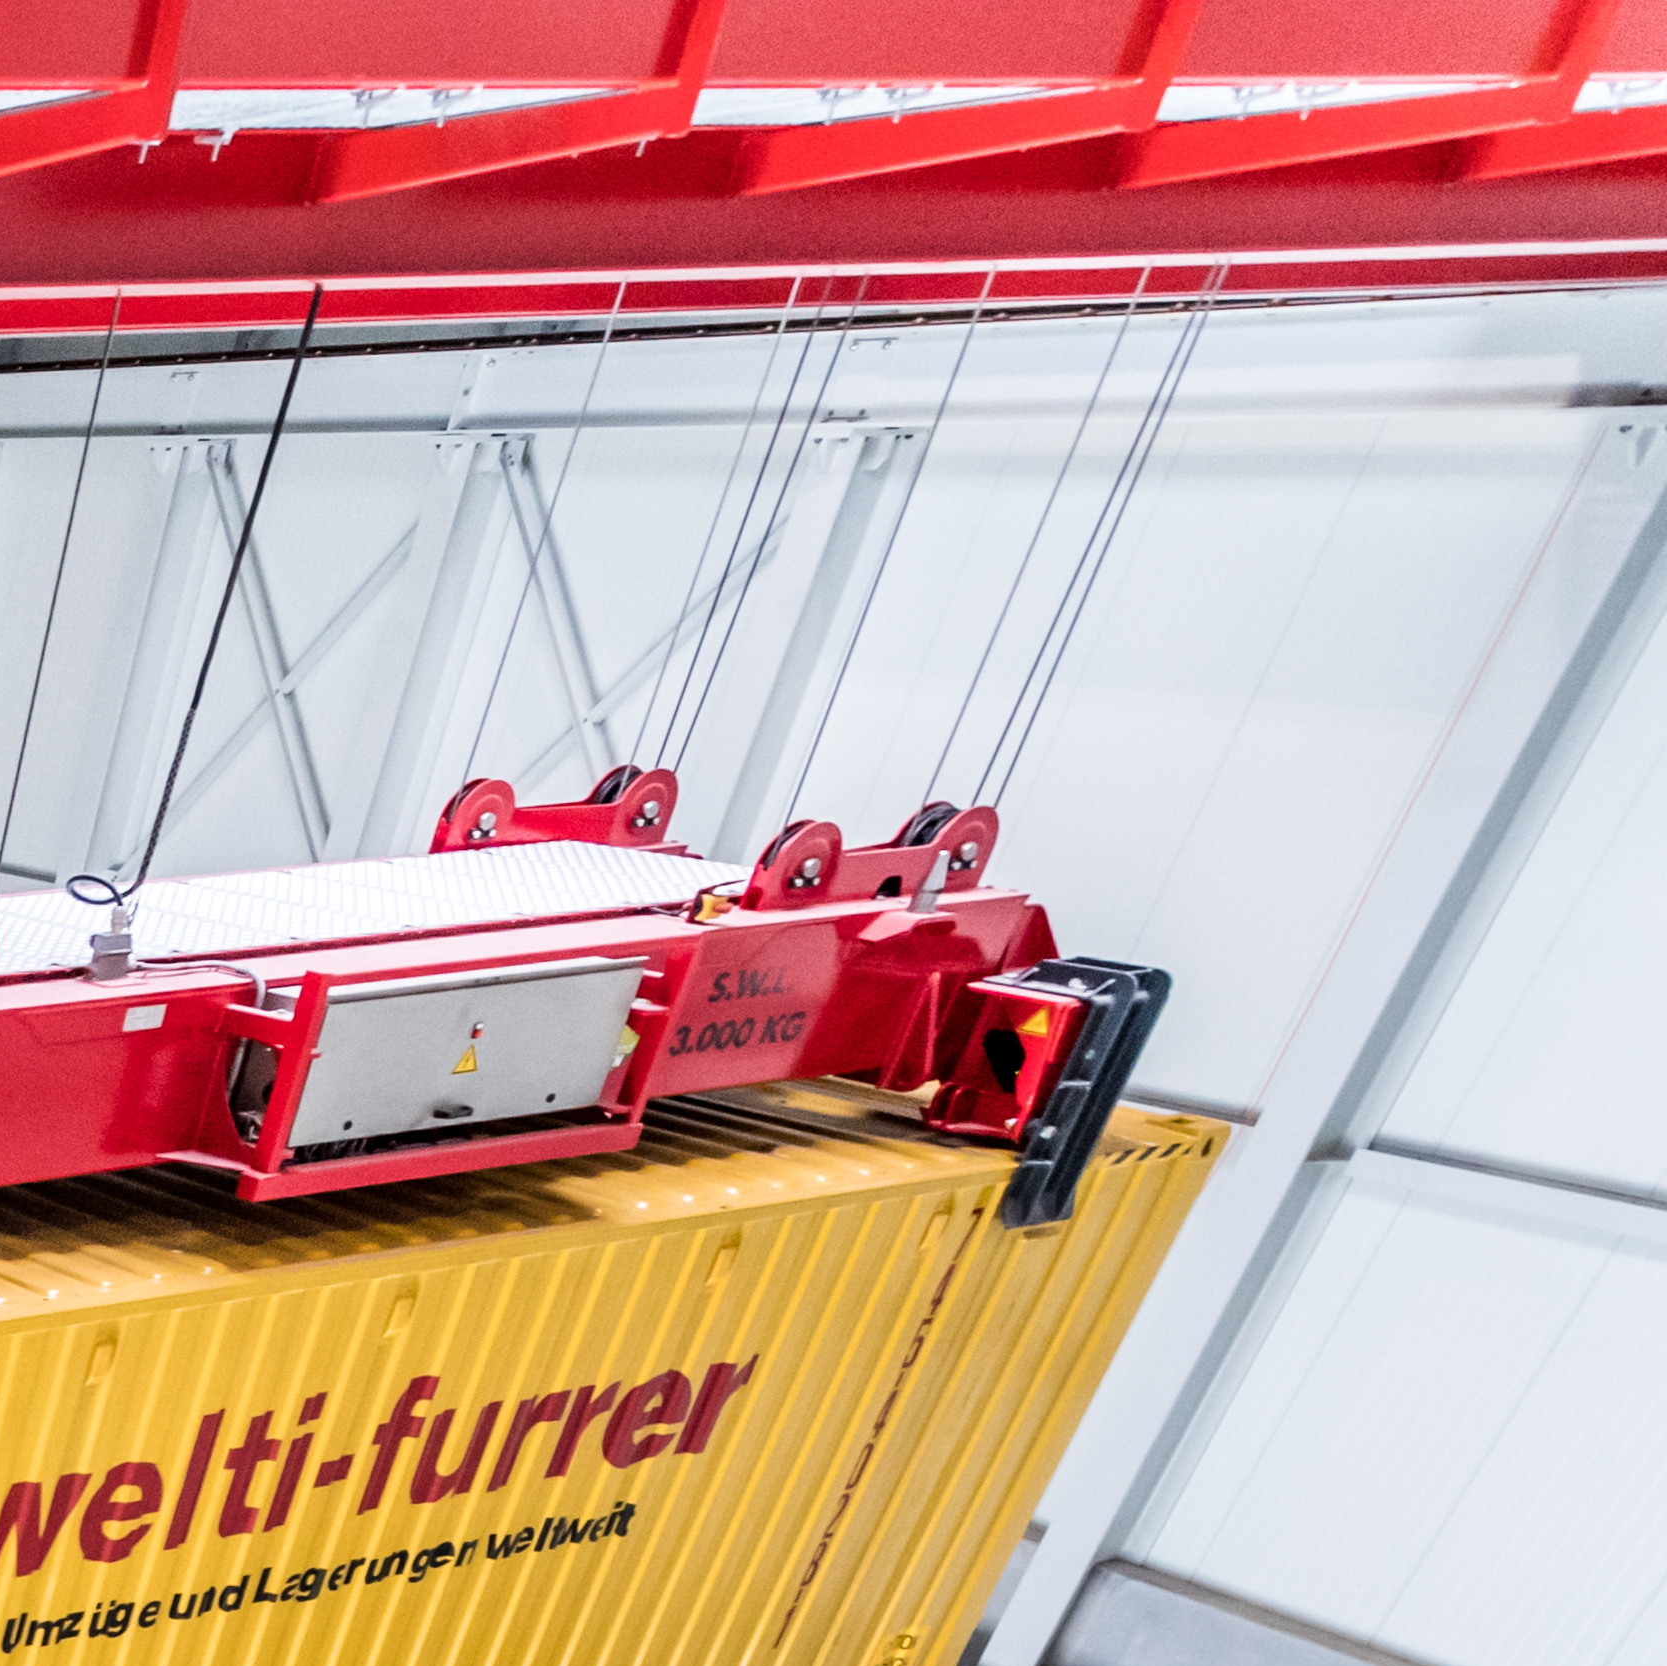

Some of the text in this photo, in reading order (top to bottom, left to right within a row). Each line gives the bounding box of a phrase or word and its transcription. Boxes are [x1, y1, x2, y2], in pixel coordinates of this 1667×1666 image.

[760, 1011, 806, 1044] KG
[0, 1501, 637, 1654] Umzüge und Lagerungen weltweit
